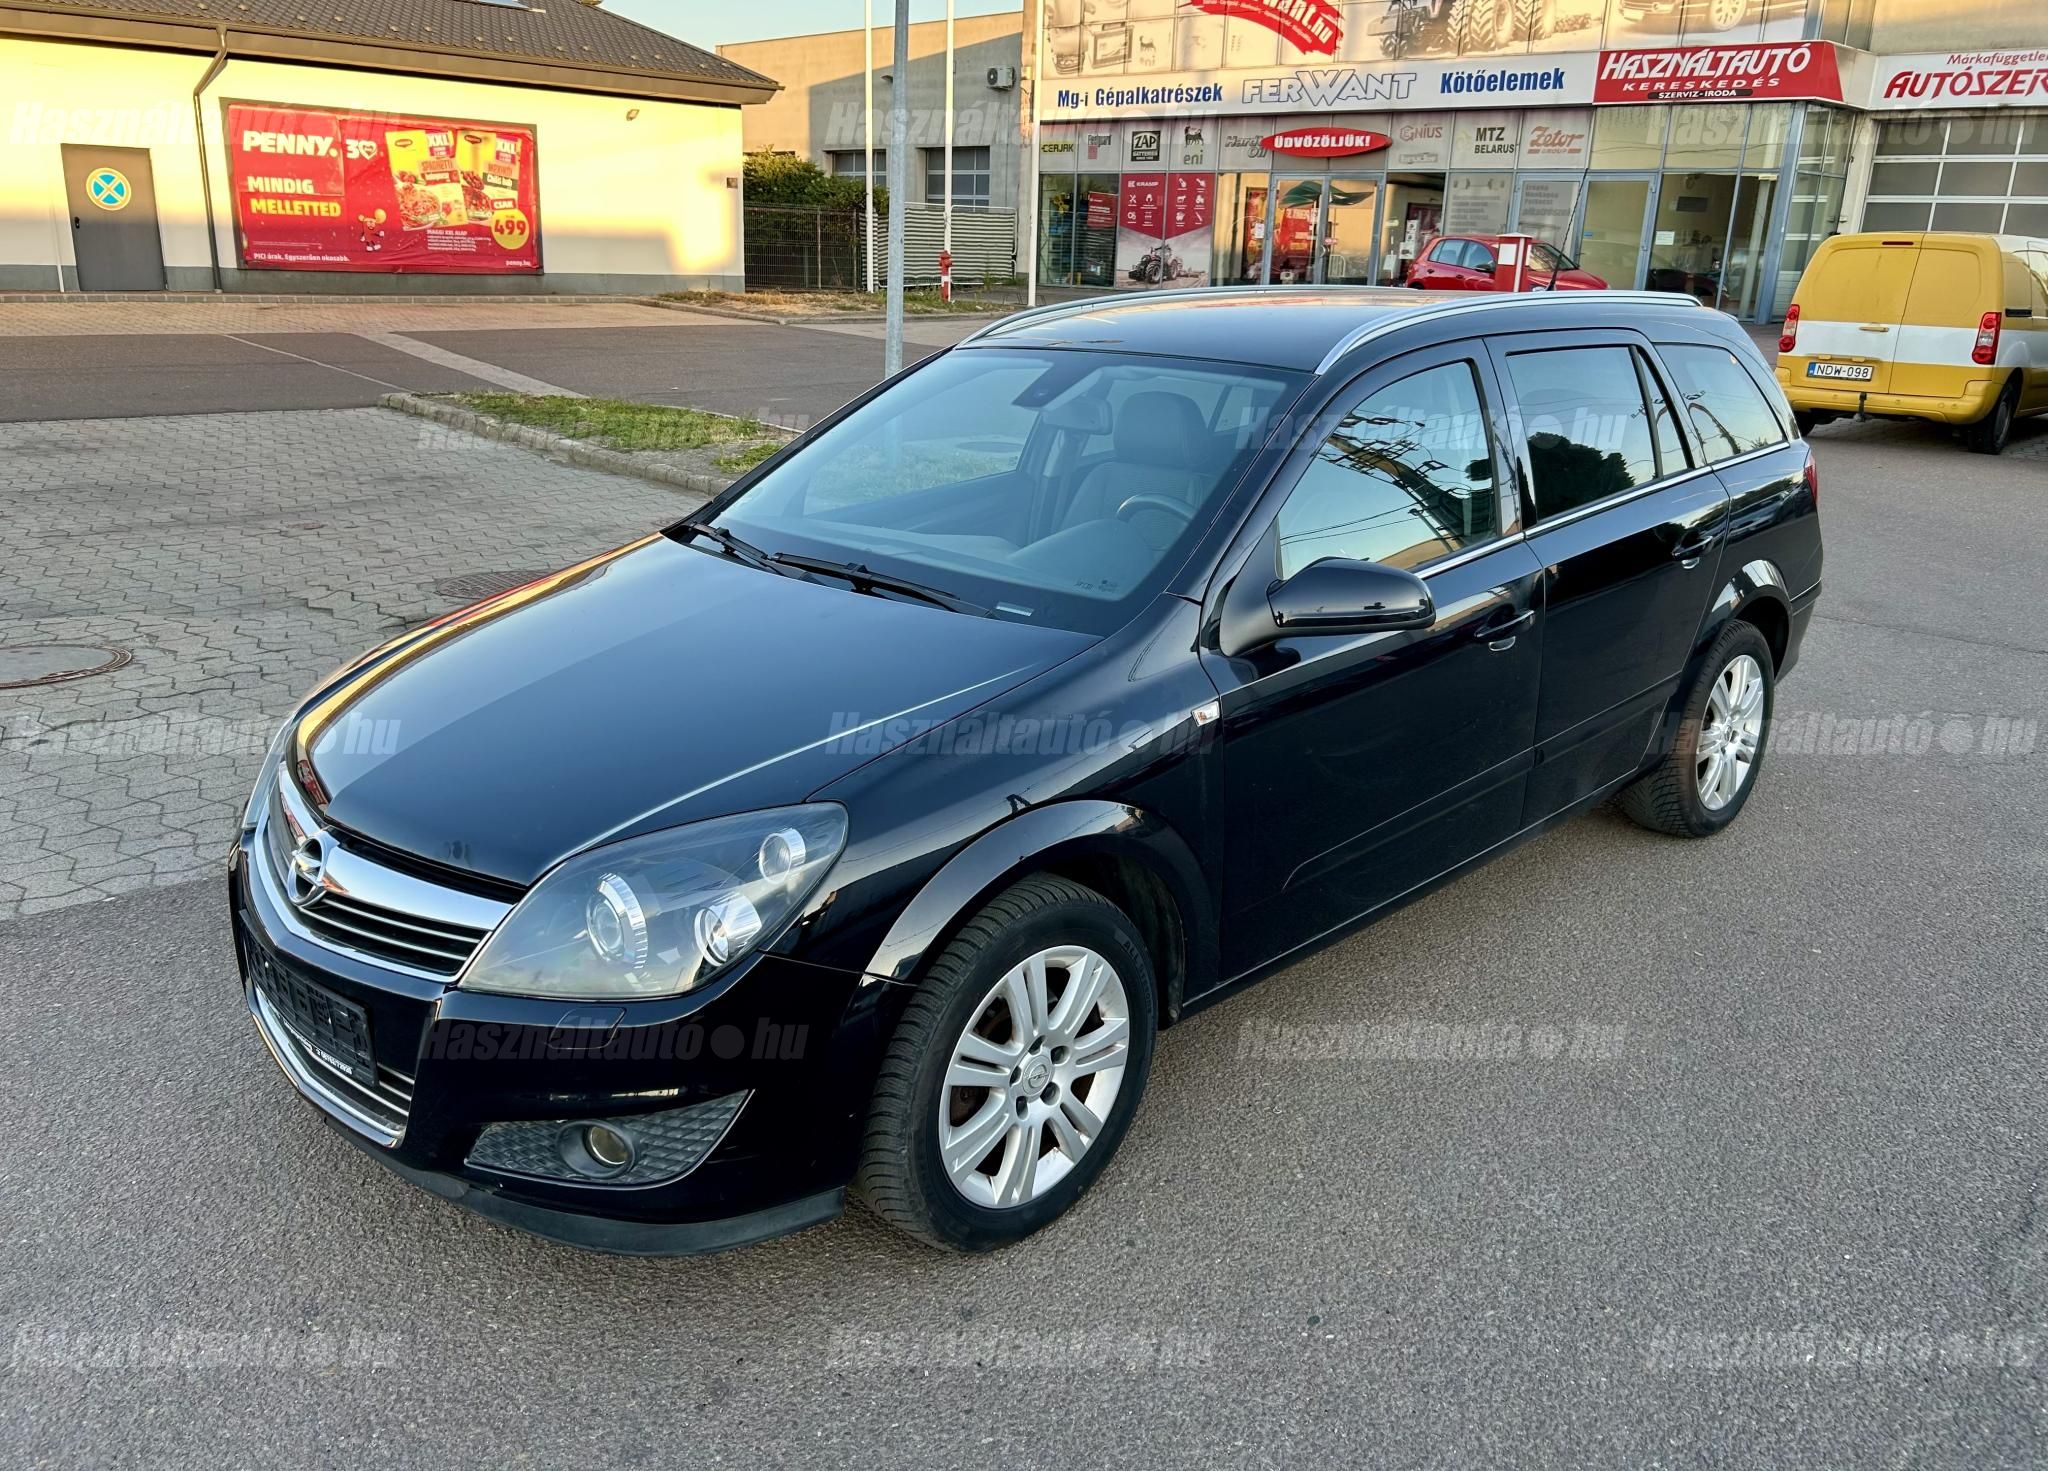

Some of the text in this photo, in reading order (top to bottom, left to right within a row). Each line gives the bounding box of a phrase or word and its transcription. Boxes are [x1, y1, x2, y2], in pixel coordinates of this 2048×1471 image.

[1600, 43, 1811, 80] HASZNÁLTAUTÓ
[1440, 68, 1565, 94] Kötőelemek
[1622, 77, 1781, 91] KERESKEDÉS
[1058, 83, 1223, 109] Mg-i Gépalkatrészek
[1134, 135, 1156, 148] ZAP
[1274, 134, 1371, 148] ÜDVÖZÖLJÜK!
[1475, 127, 1505, 141] MTZ
[1474, 144, 1514, 154] BELARUS
[1184, 150, 1204, 165] eni
[248, 176, 315, 194] MINDIG
[251, 198, 342, 217] MELLETTED
[494, 219, 526, 236] 499
[1817, 365, 1869, 378] NDW-098
